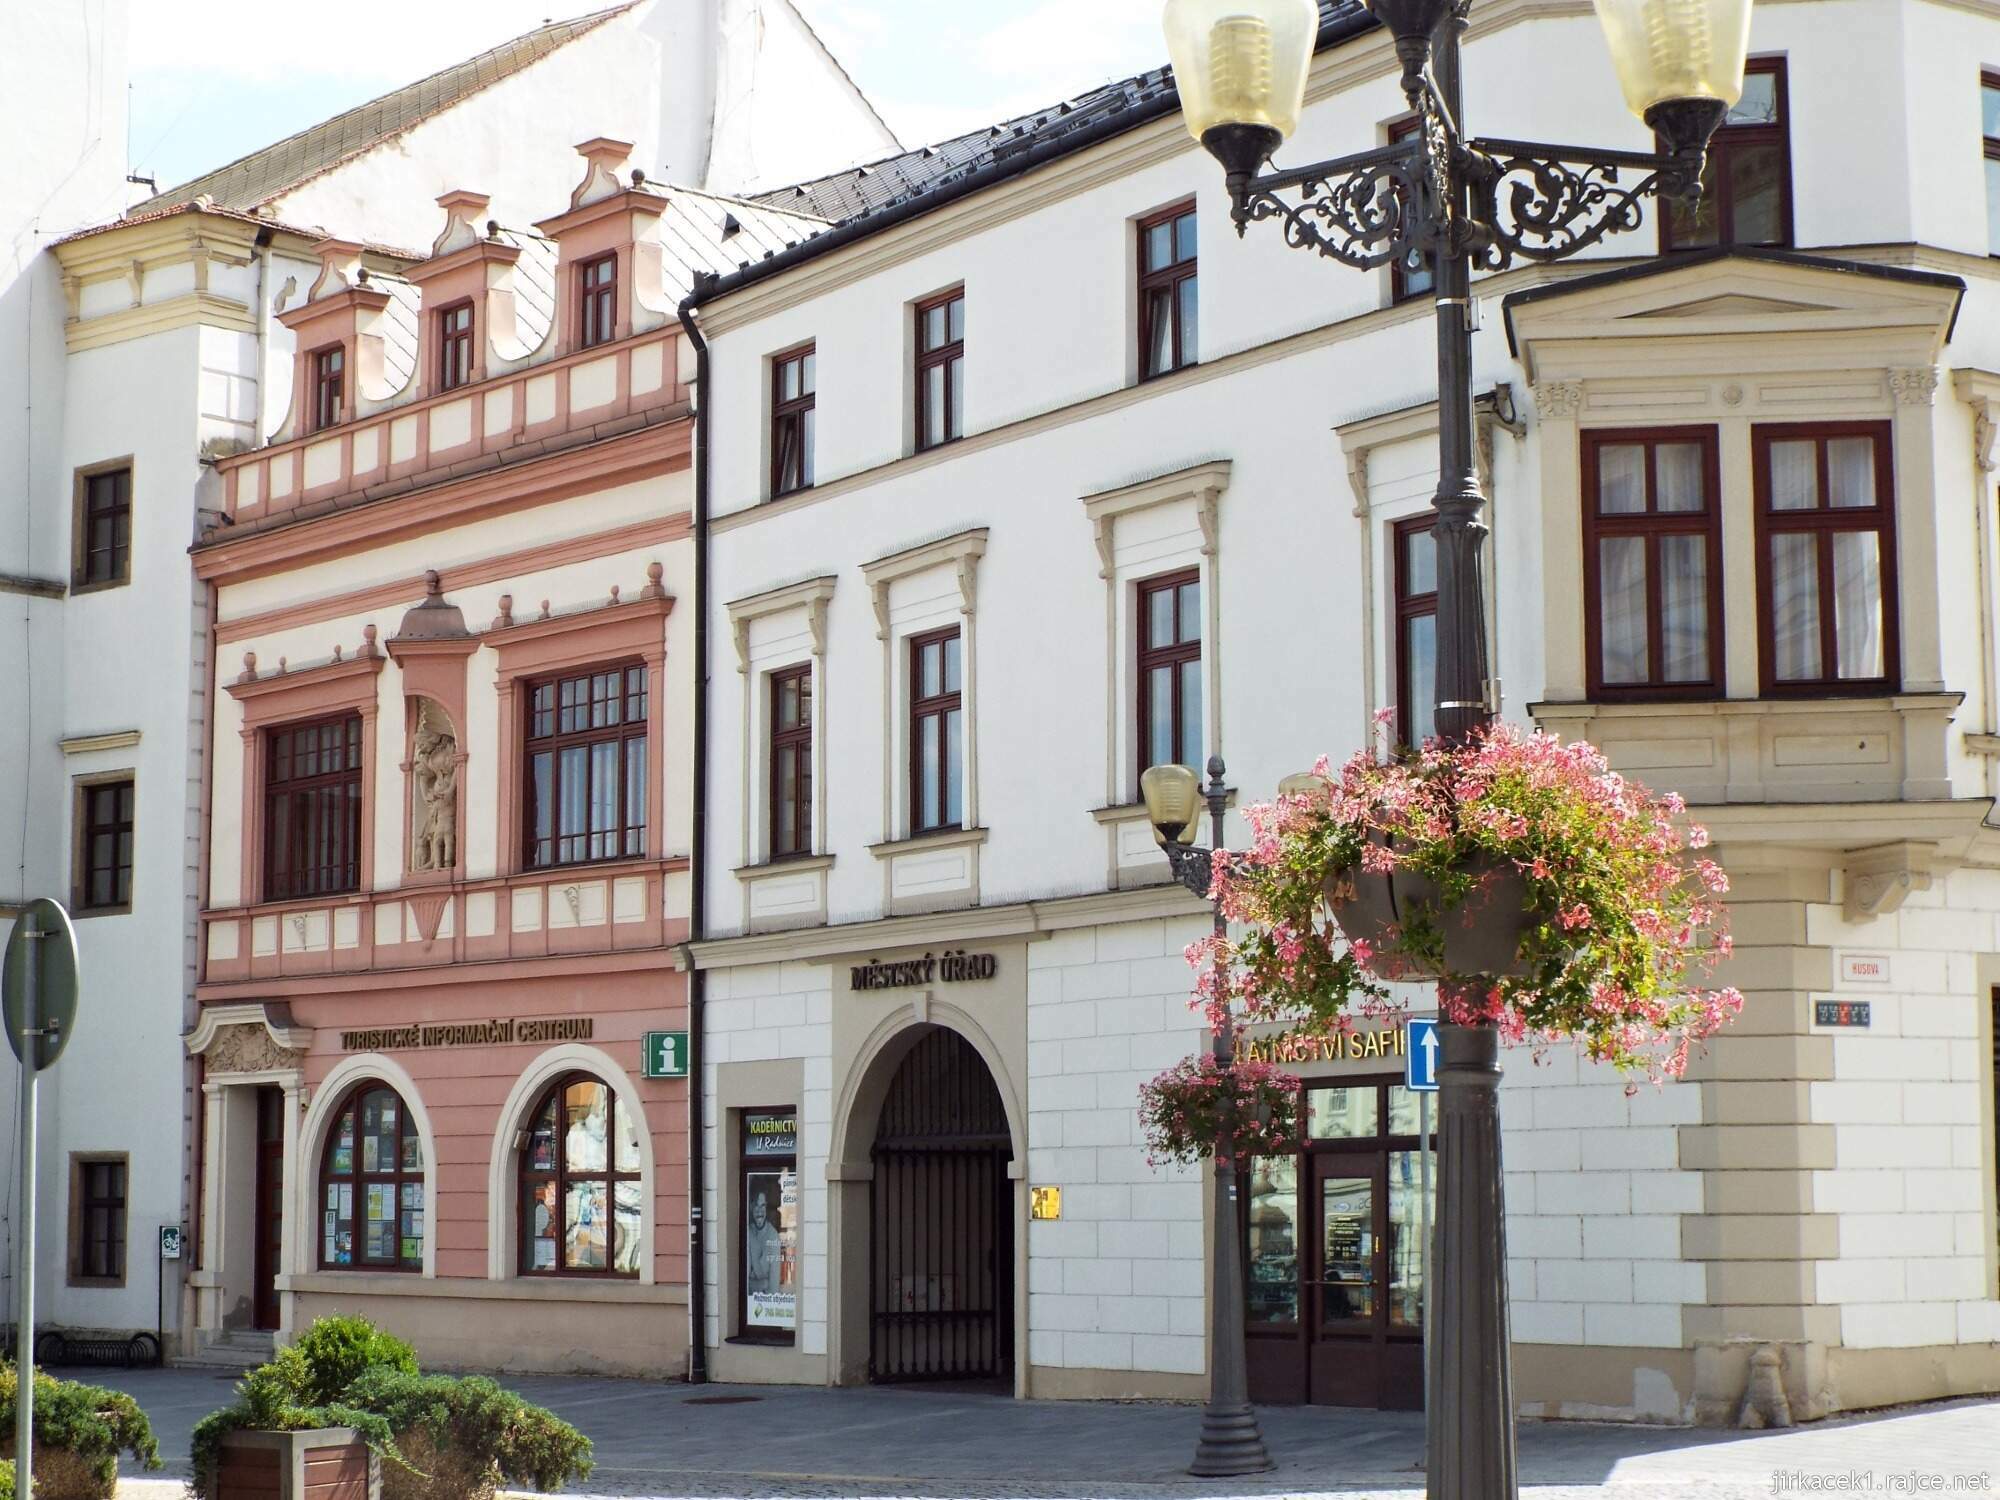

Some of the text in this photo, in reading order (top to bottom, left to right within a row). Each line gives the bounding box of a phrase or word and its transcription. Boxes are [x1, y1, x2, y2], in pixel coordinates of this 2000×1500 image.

[850, 950, 998, 990] MĚSTSKÝ ÚŘAD
[340, 1018, 594, 1050] TURISTICKÉ INFORMAČNÍ CENTRUM
[750, 1117, 798, 1134] KADEŘNICTV
